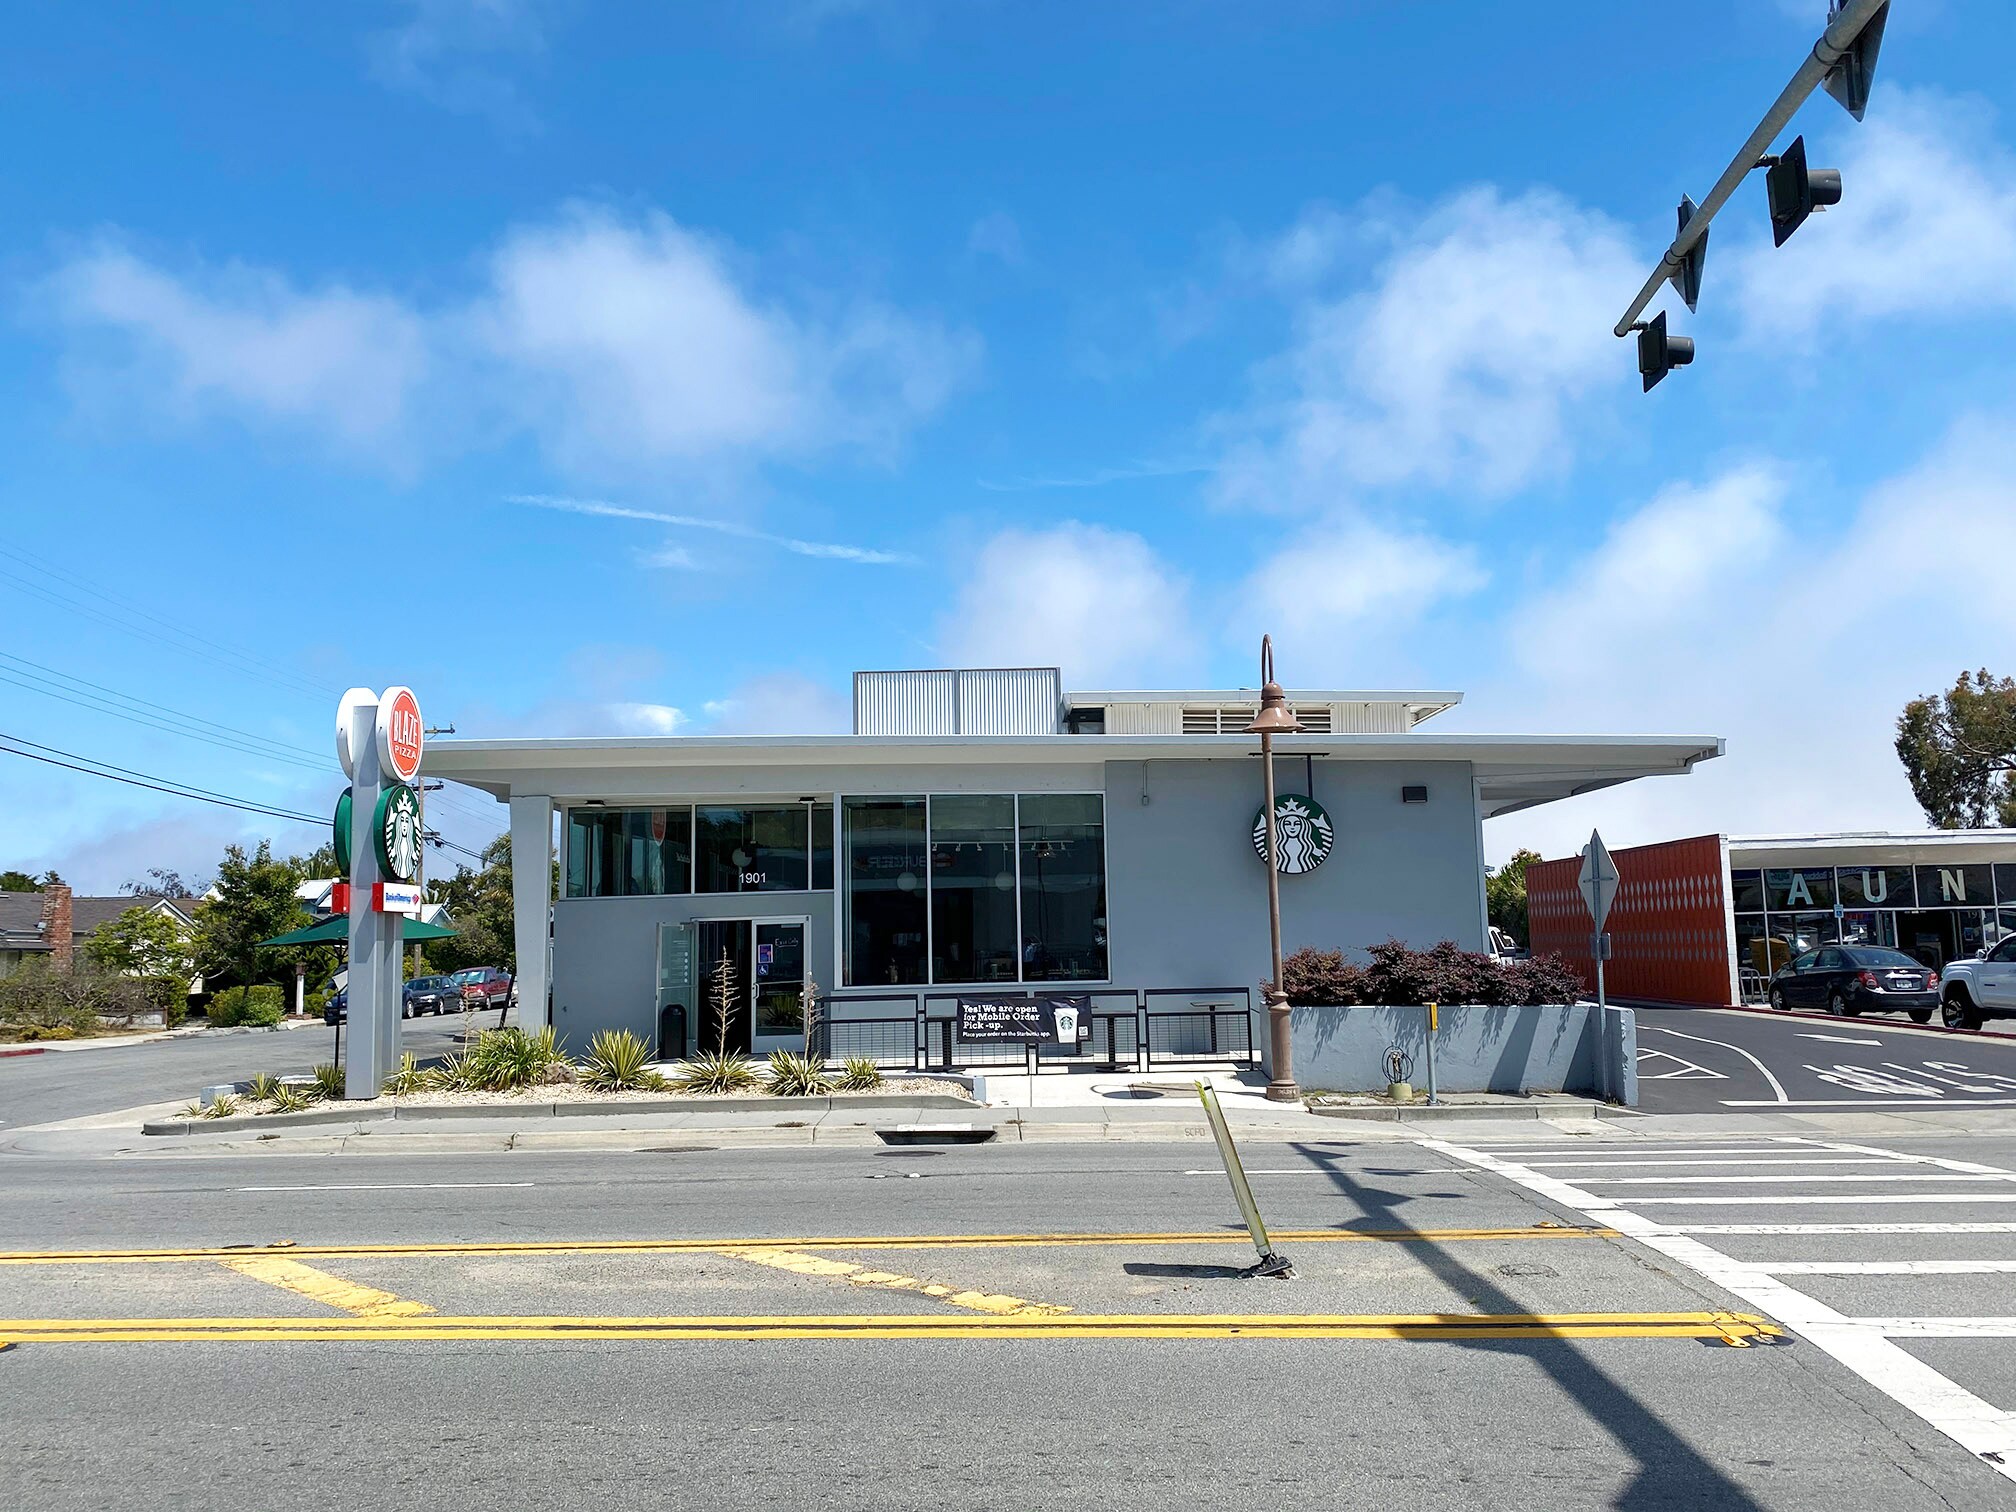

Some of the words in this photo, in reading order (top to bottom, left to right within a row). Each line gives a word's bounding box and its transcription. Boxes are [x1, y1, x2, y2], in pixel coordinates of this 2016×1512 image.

[393, 710, 418, 749] BLAZE
[394, 745, 417, 760] PIZZA
[739, 872, 766, 884] 1901
[963, 1004, 981, 1013] Yes!
[982, 1004, 996, 1013] We
[999, 1005, 1013, 1013] are
[1015, 1006, 1038, 1014] open
[963, 1012, 976, 1021] for
[978, 1012, 1010, 1021] Mobile
[1012, 1012, 1040, 1021] Order
[963, 1021, 984, 1029] Pick
